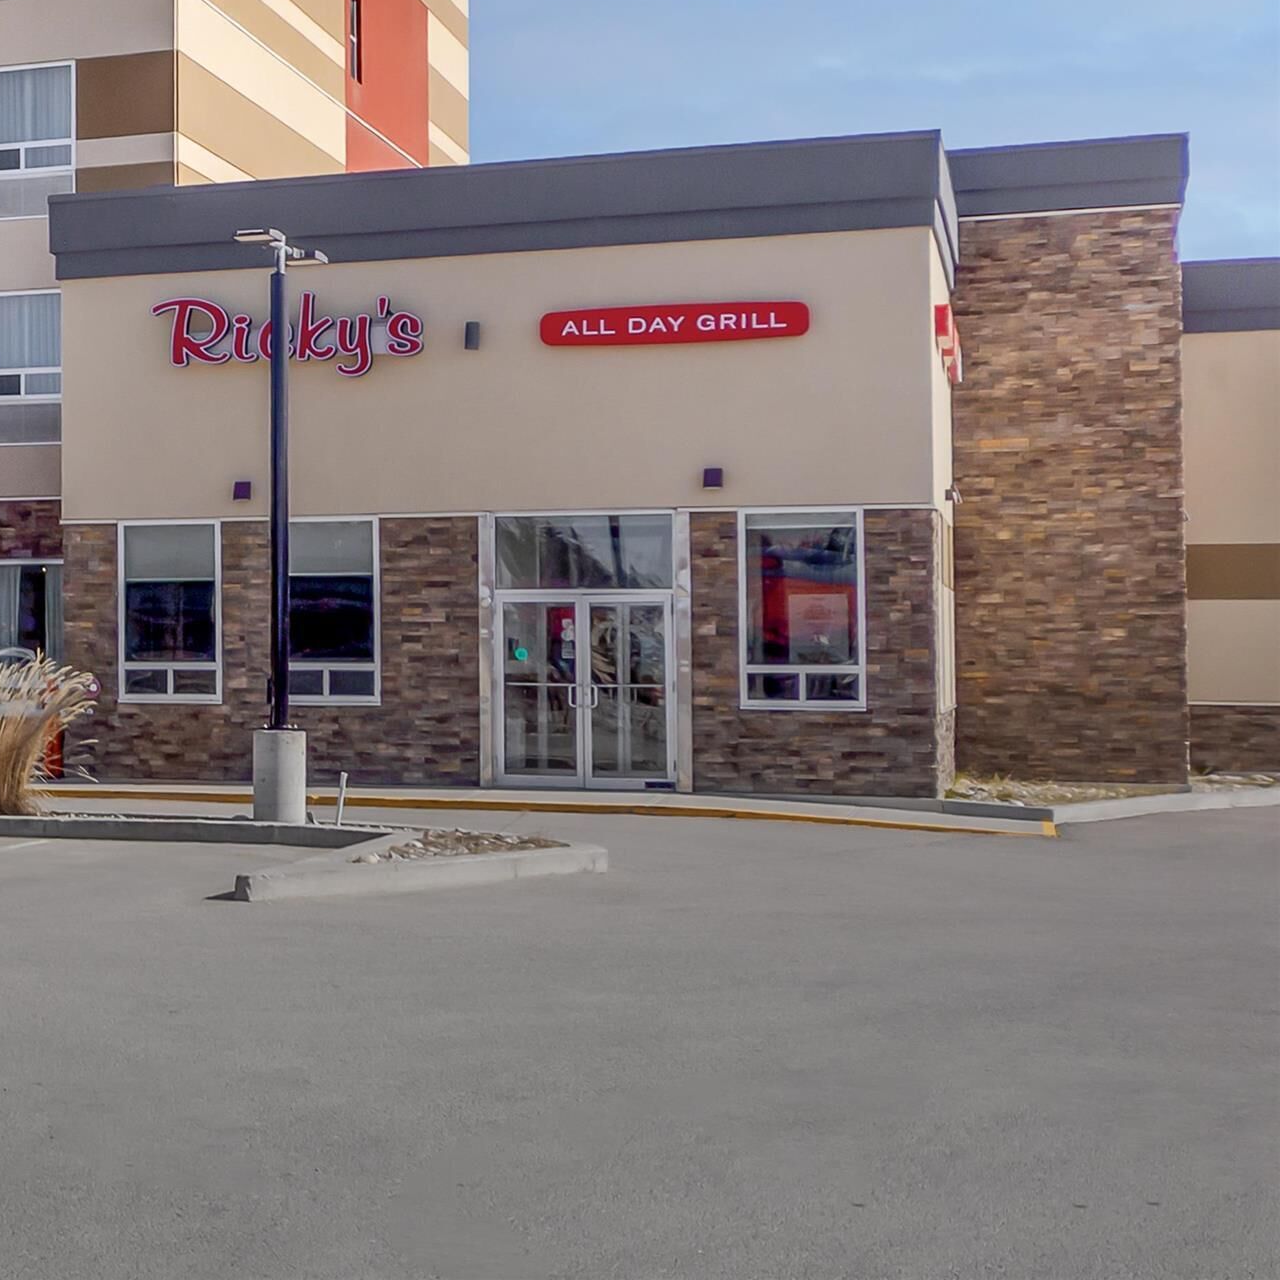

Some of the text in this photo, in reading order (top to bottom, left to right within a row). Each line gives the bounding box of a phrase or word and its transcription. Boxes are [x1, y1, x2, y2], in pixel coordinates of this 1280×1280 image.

[561, 312, 788, 336] ALL DAY GRILL
